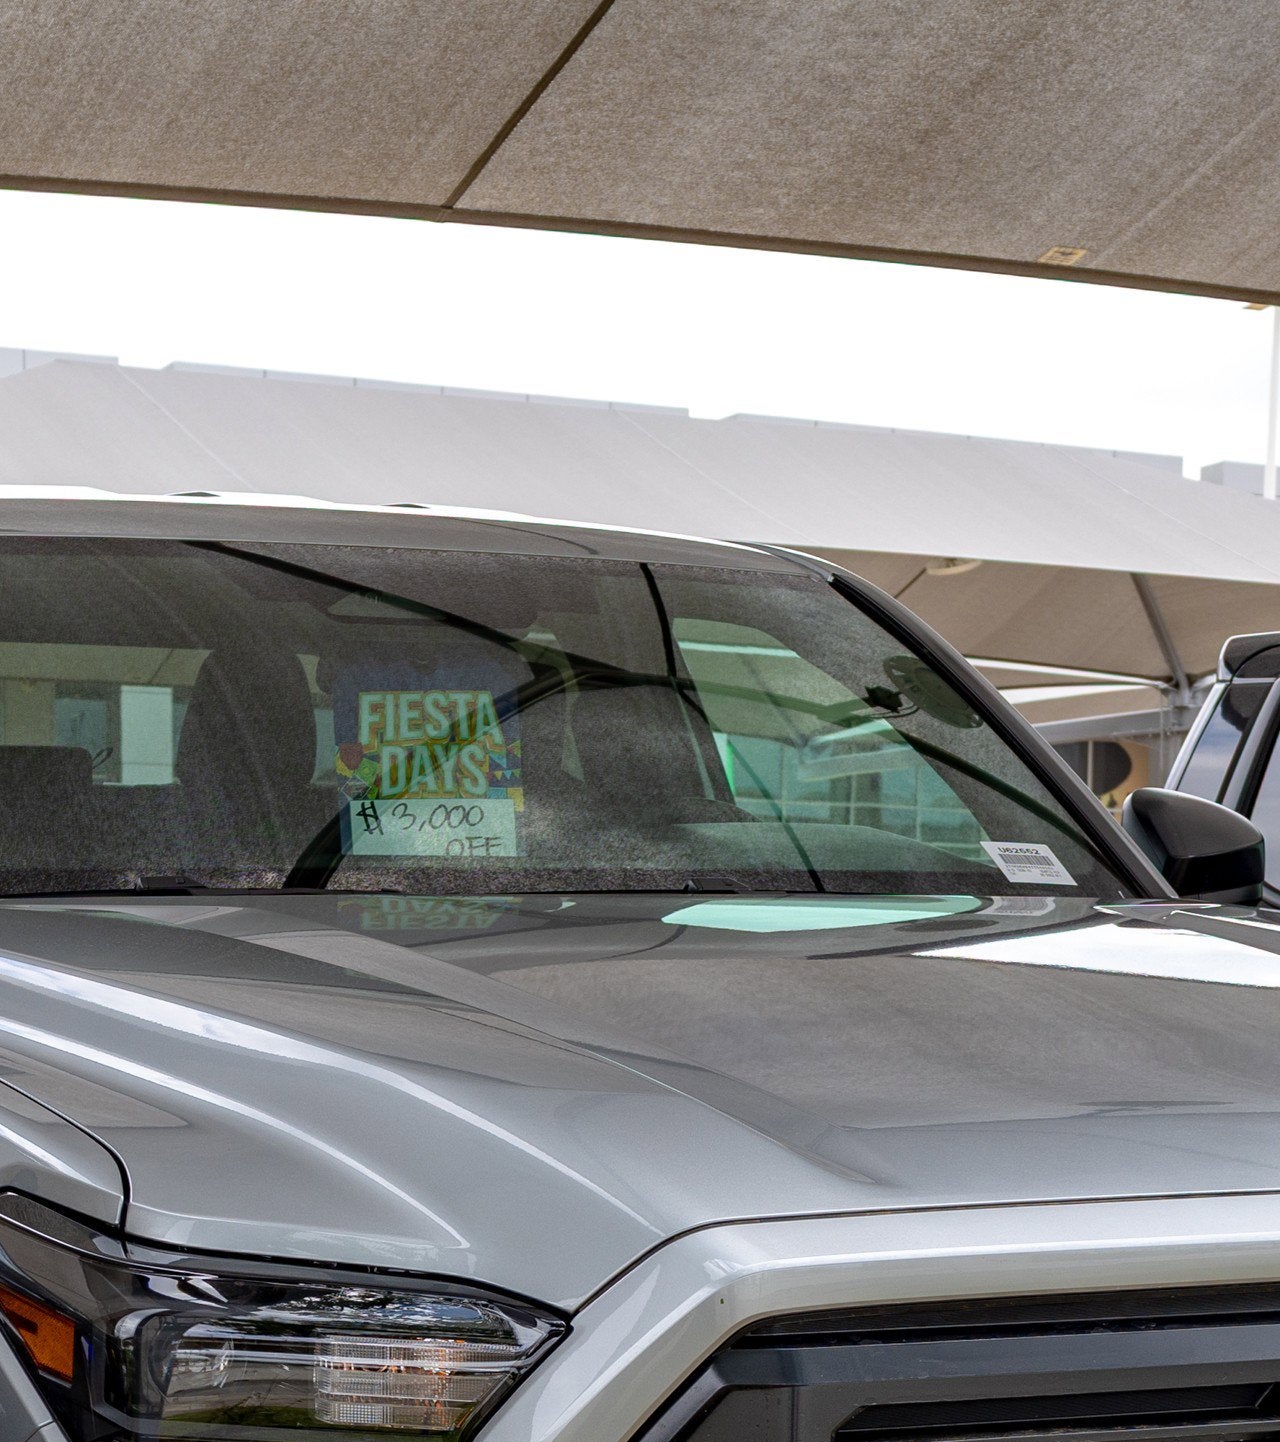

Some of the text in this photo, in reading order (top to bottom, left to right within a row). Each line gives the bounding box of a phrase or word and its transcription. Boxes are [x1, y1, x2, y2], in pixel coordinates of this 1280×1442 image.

[359, 691, 506, 747] FIESTA
[380, 744, 490, 797] DAYS
[445, 836, 503, 858] OFF
